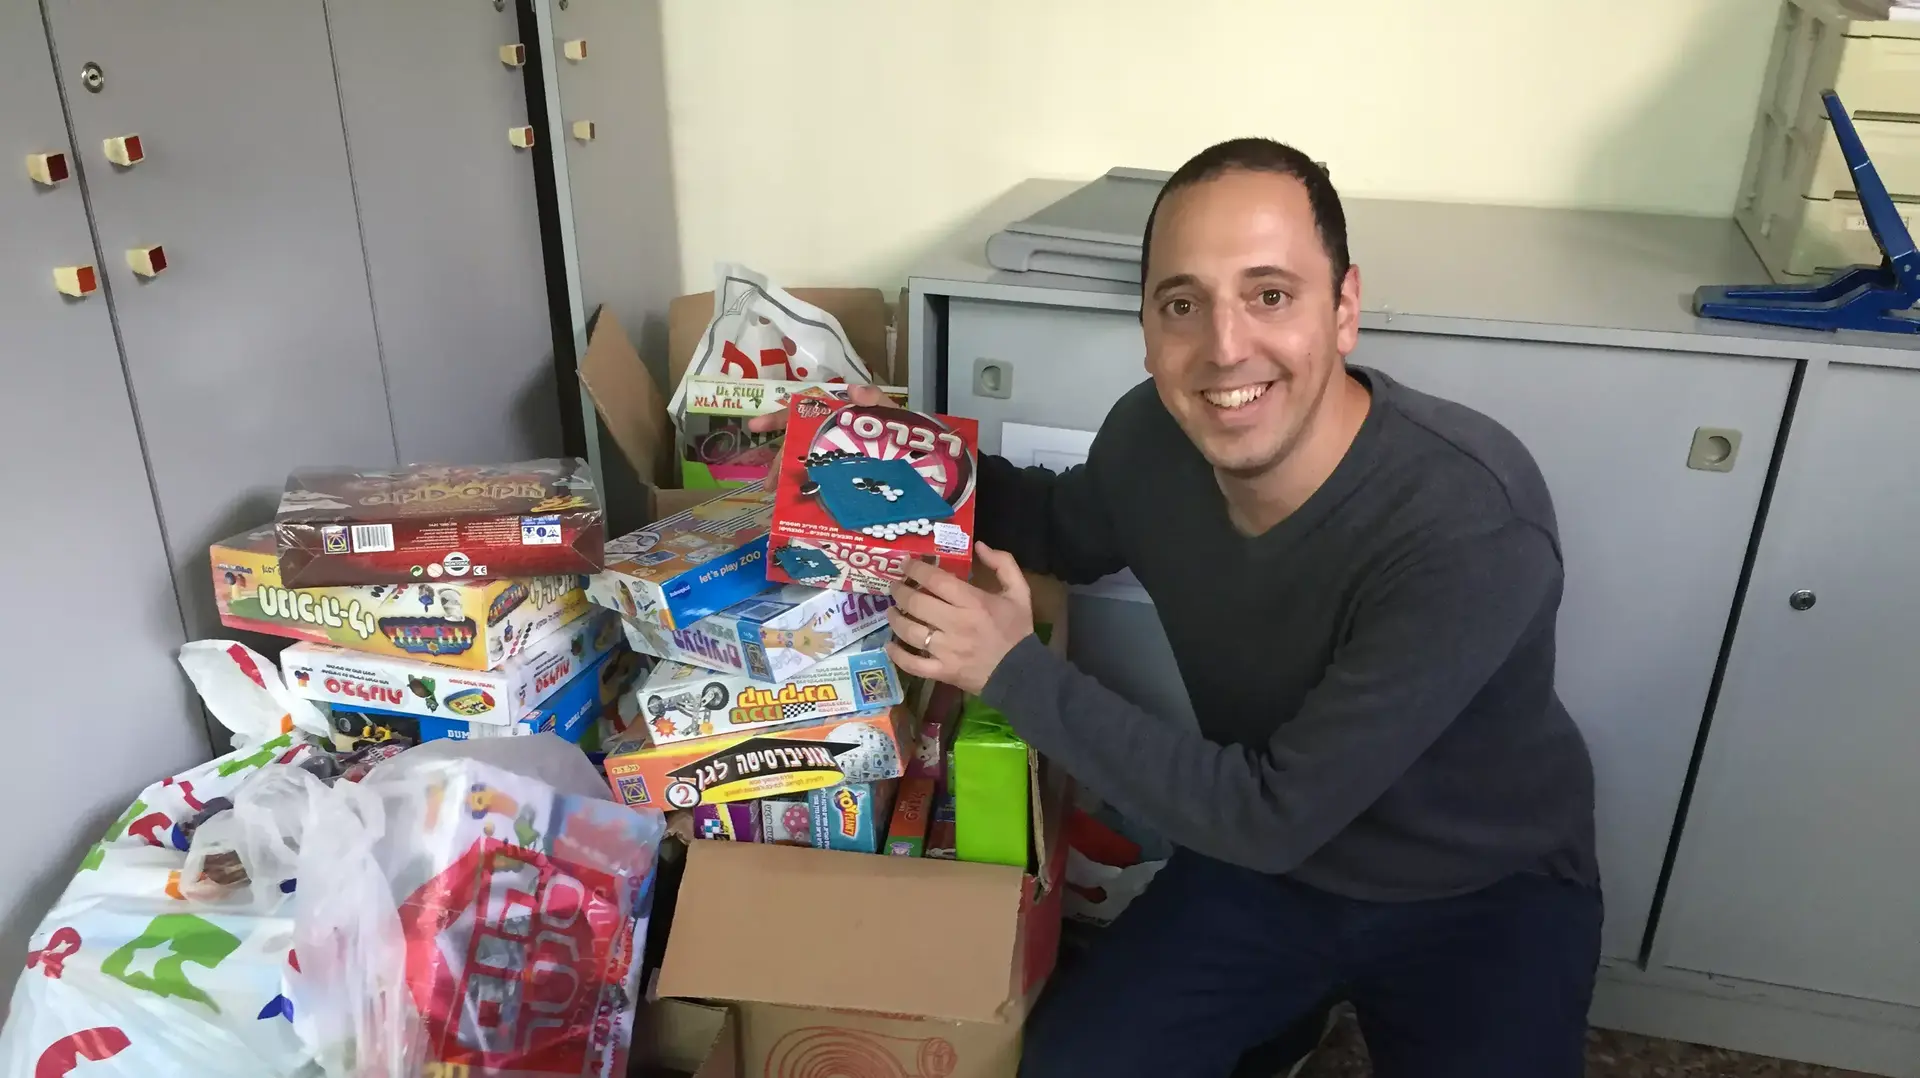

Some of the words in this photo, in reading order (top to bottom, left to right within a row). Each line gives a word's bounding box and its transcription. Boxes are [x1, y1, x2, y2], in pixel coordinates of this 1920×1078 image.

[694, 395, 719, 408] ארץ
[723, 398, 743, 409] עיר
[732, 386, 764, 399] צומח
[838, 411, 962, 457] רברסי
[698, 570, 720, 584] let's
[720, 561, 738, 577] play
[739, 550, 761, 566] ZOO
[840, 548, 909, 573] ברסי
[257, 584, 375, 639] חנוכיה-לי
[672, 630, 742, 669] קעקועים
[535, 659, 571, 694] סבלנות
[323, 677, 403, 705] סבלנות
[736, 682, 838, 709] קורקינט
[729, 706, 784, 725] טכנו
[447, 729, 470, 739] DUM
[736, 745, 836, 773] אוניברסיטה
[695, 761, 729, 791] לגן
[675, 785, 692, 805] 2
